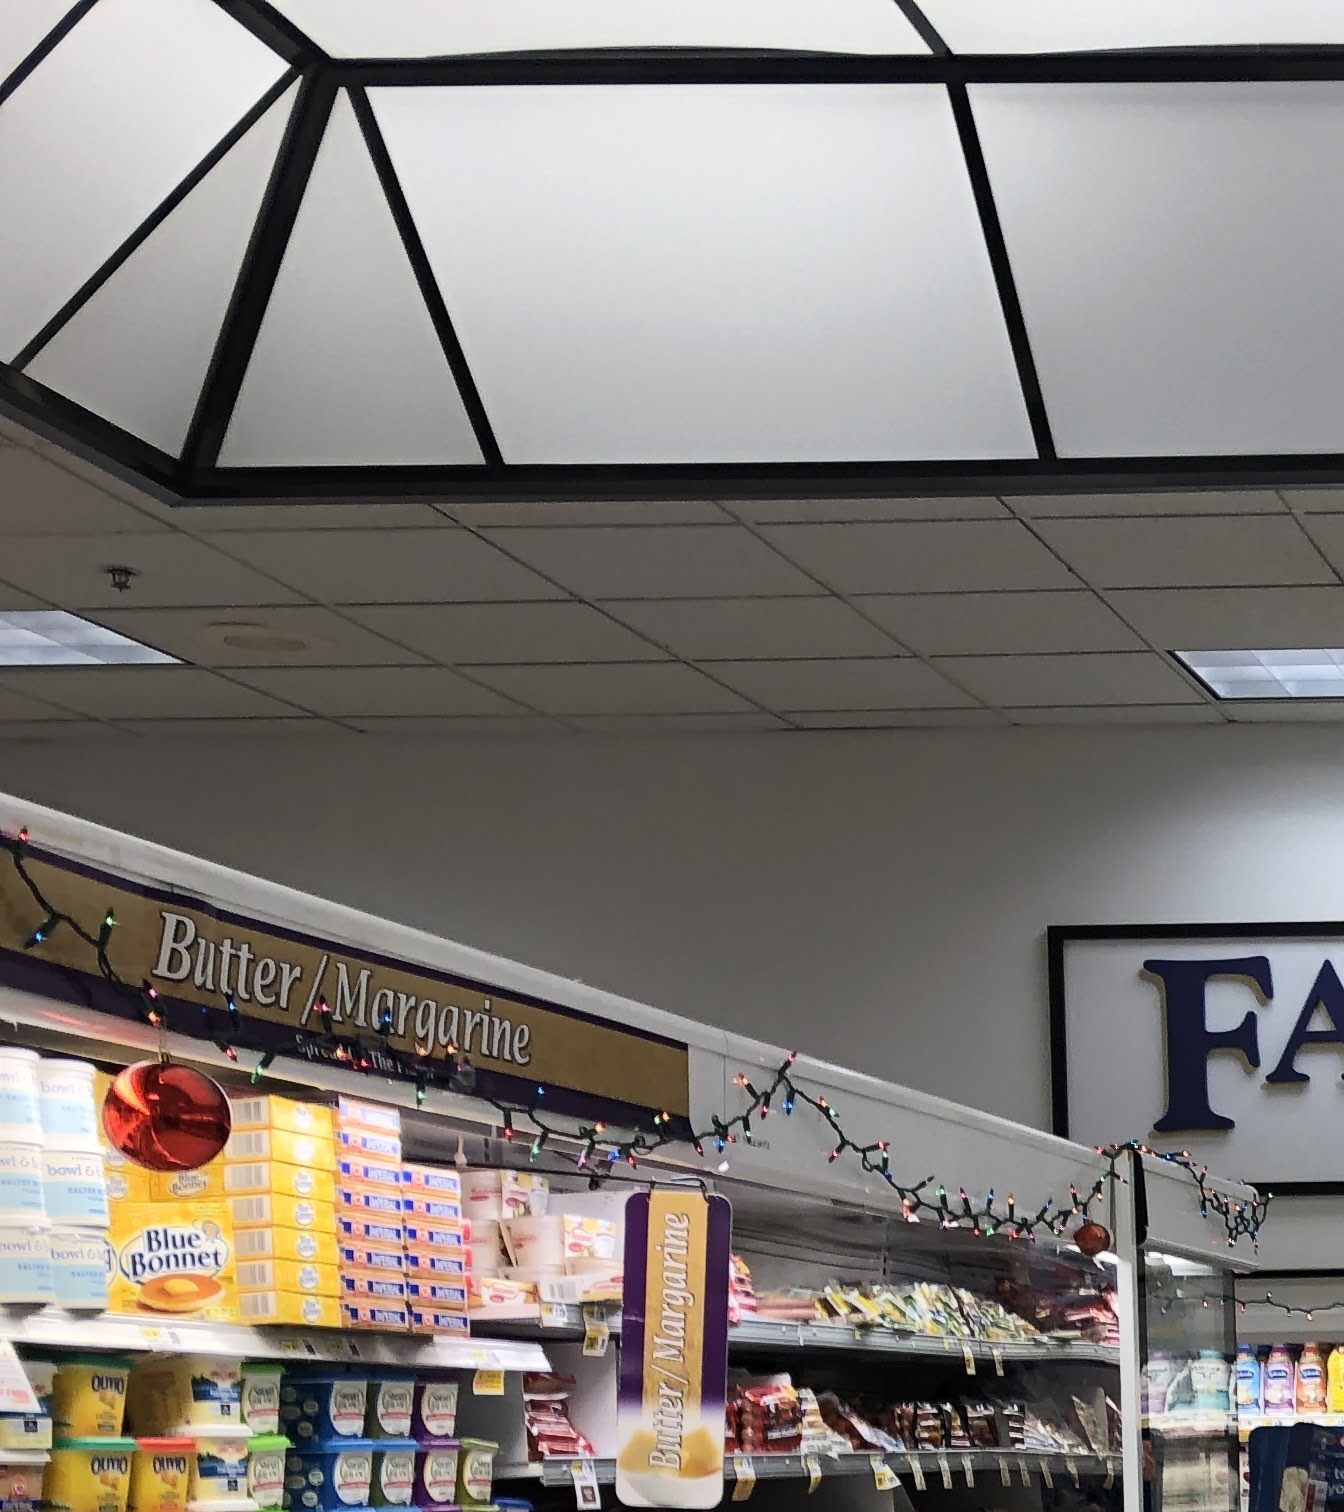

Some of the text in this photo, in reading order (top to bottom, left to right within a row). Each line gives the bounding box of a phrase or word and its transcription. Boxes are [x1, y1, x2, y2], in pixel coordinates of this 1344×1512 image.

[47, 1164, 82, 1177] bowl
[146, 1228, 202, 1250] Blue
[50, 1248, 84, 1261] bowl
[130, 1248, 222, 1277] Bonnet
